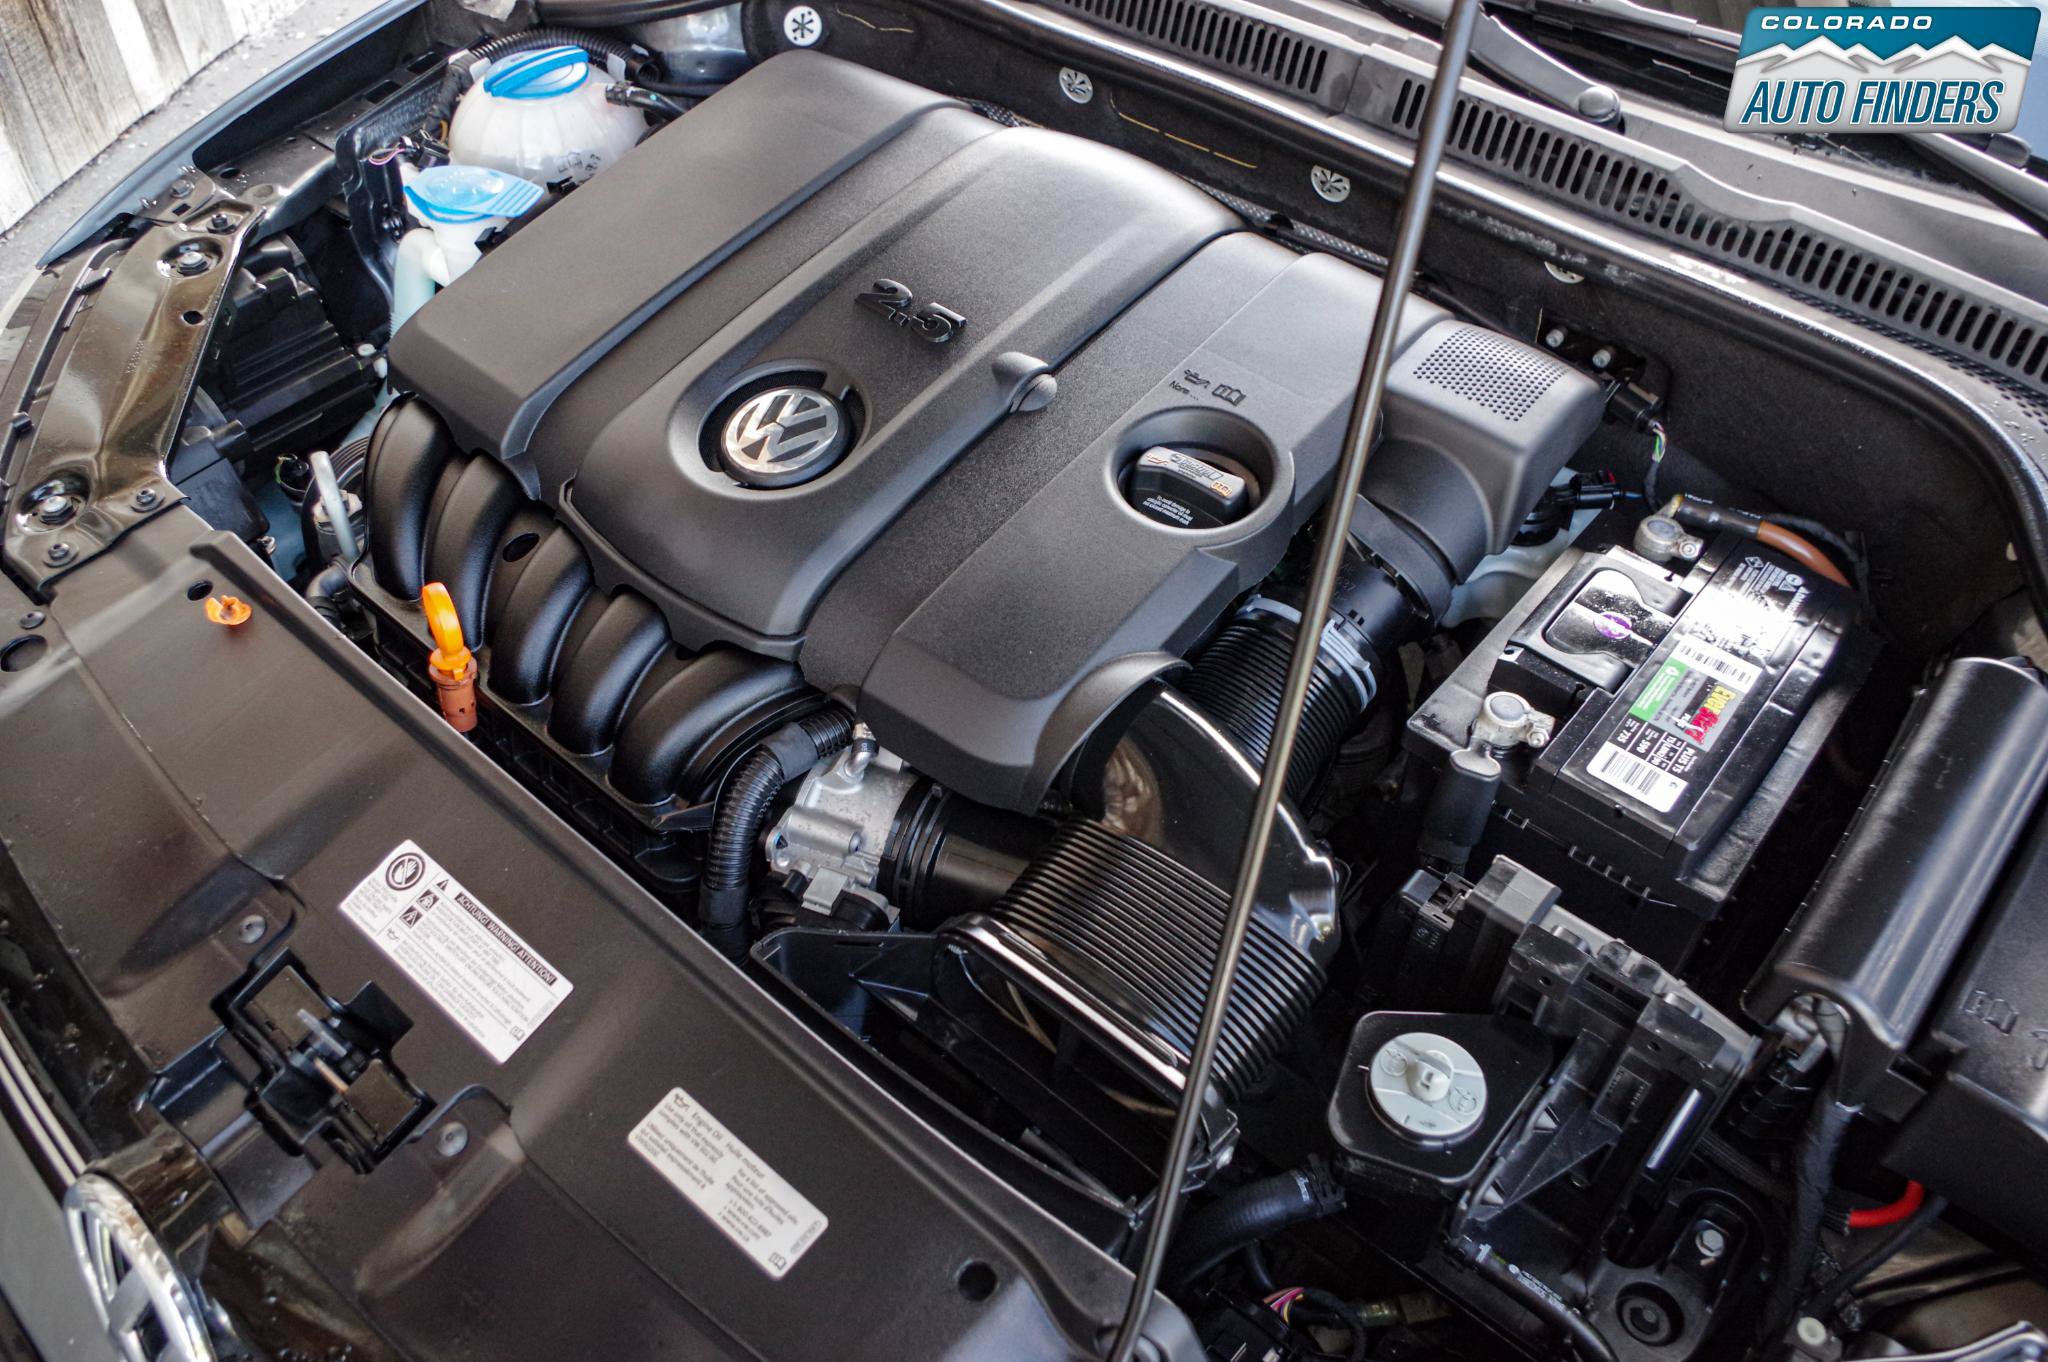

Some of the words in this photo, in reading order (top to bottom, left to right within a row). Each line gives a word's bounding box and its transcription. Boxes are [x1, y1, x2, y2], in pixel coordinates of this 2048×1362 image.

[854, 278, 968, 343] 2.5
[1683, 684, 1738, 744] EverStart
[1635, 738, 1650, 754] 590
[1677, 745, 1695, 766] PLUS
[457, 894, 489, 925] ACHTUNG!
[486, 921, 520, 952] WARNING!
[516, 948, 554, 983] ATTENTION!
